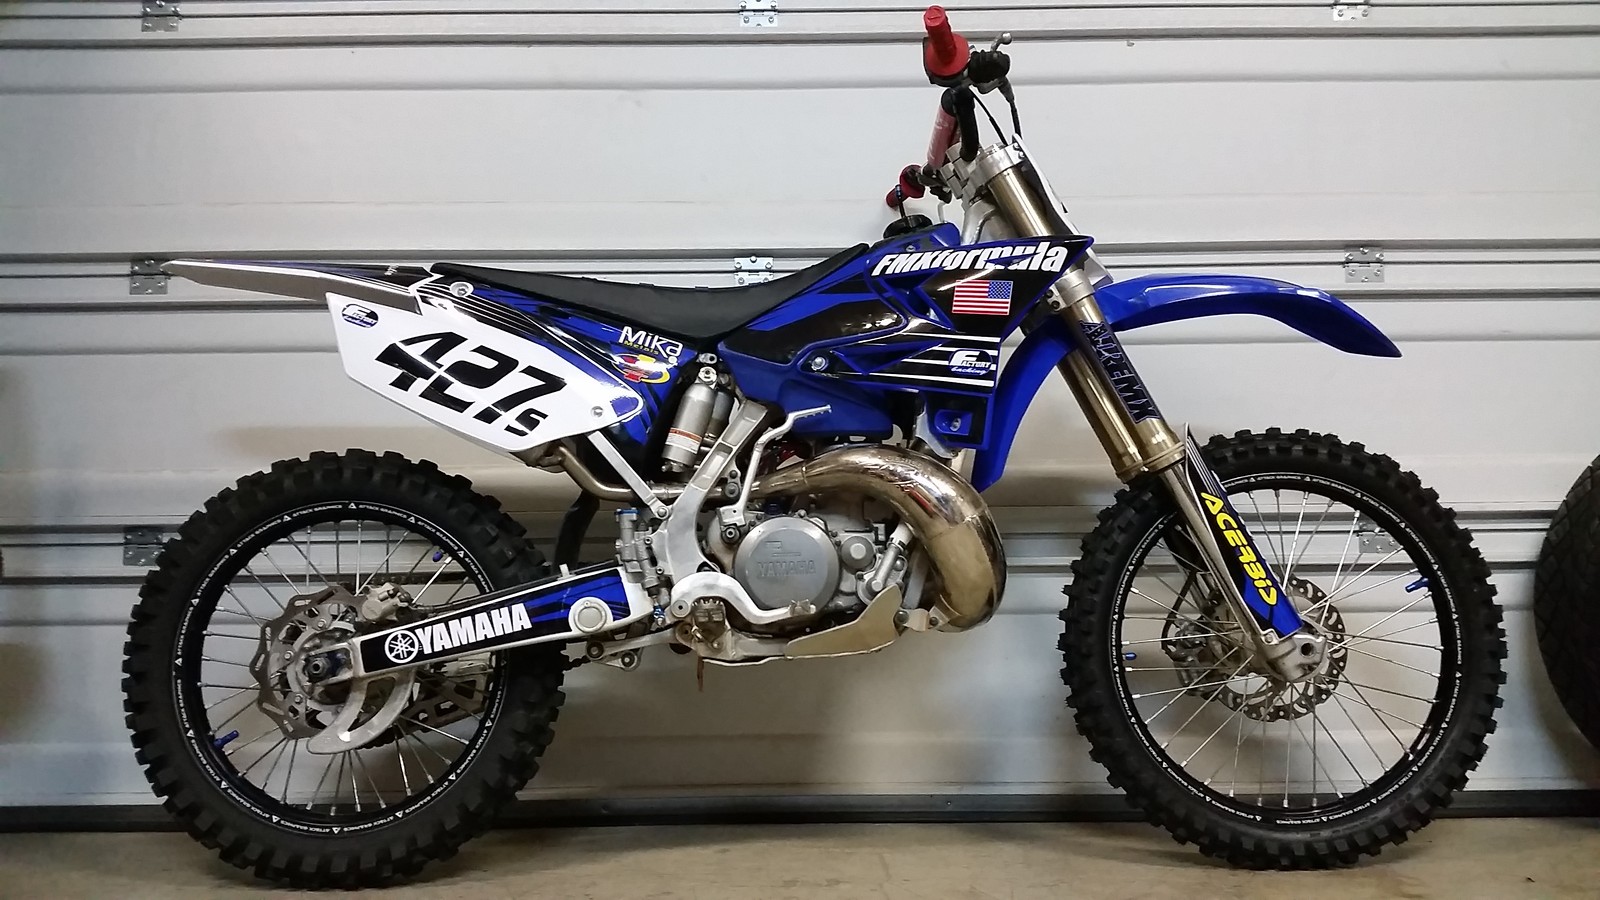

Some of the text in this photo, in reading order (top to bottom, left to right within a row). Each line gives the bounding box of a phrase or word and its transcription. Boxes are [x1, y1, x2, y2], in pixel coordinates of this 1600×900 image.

[619, 326, 683, 363] Mika
[757, 559, 816, 577] YAMAHA
[415, 603, 532, 654] YAMAHA
